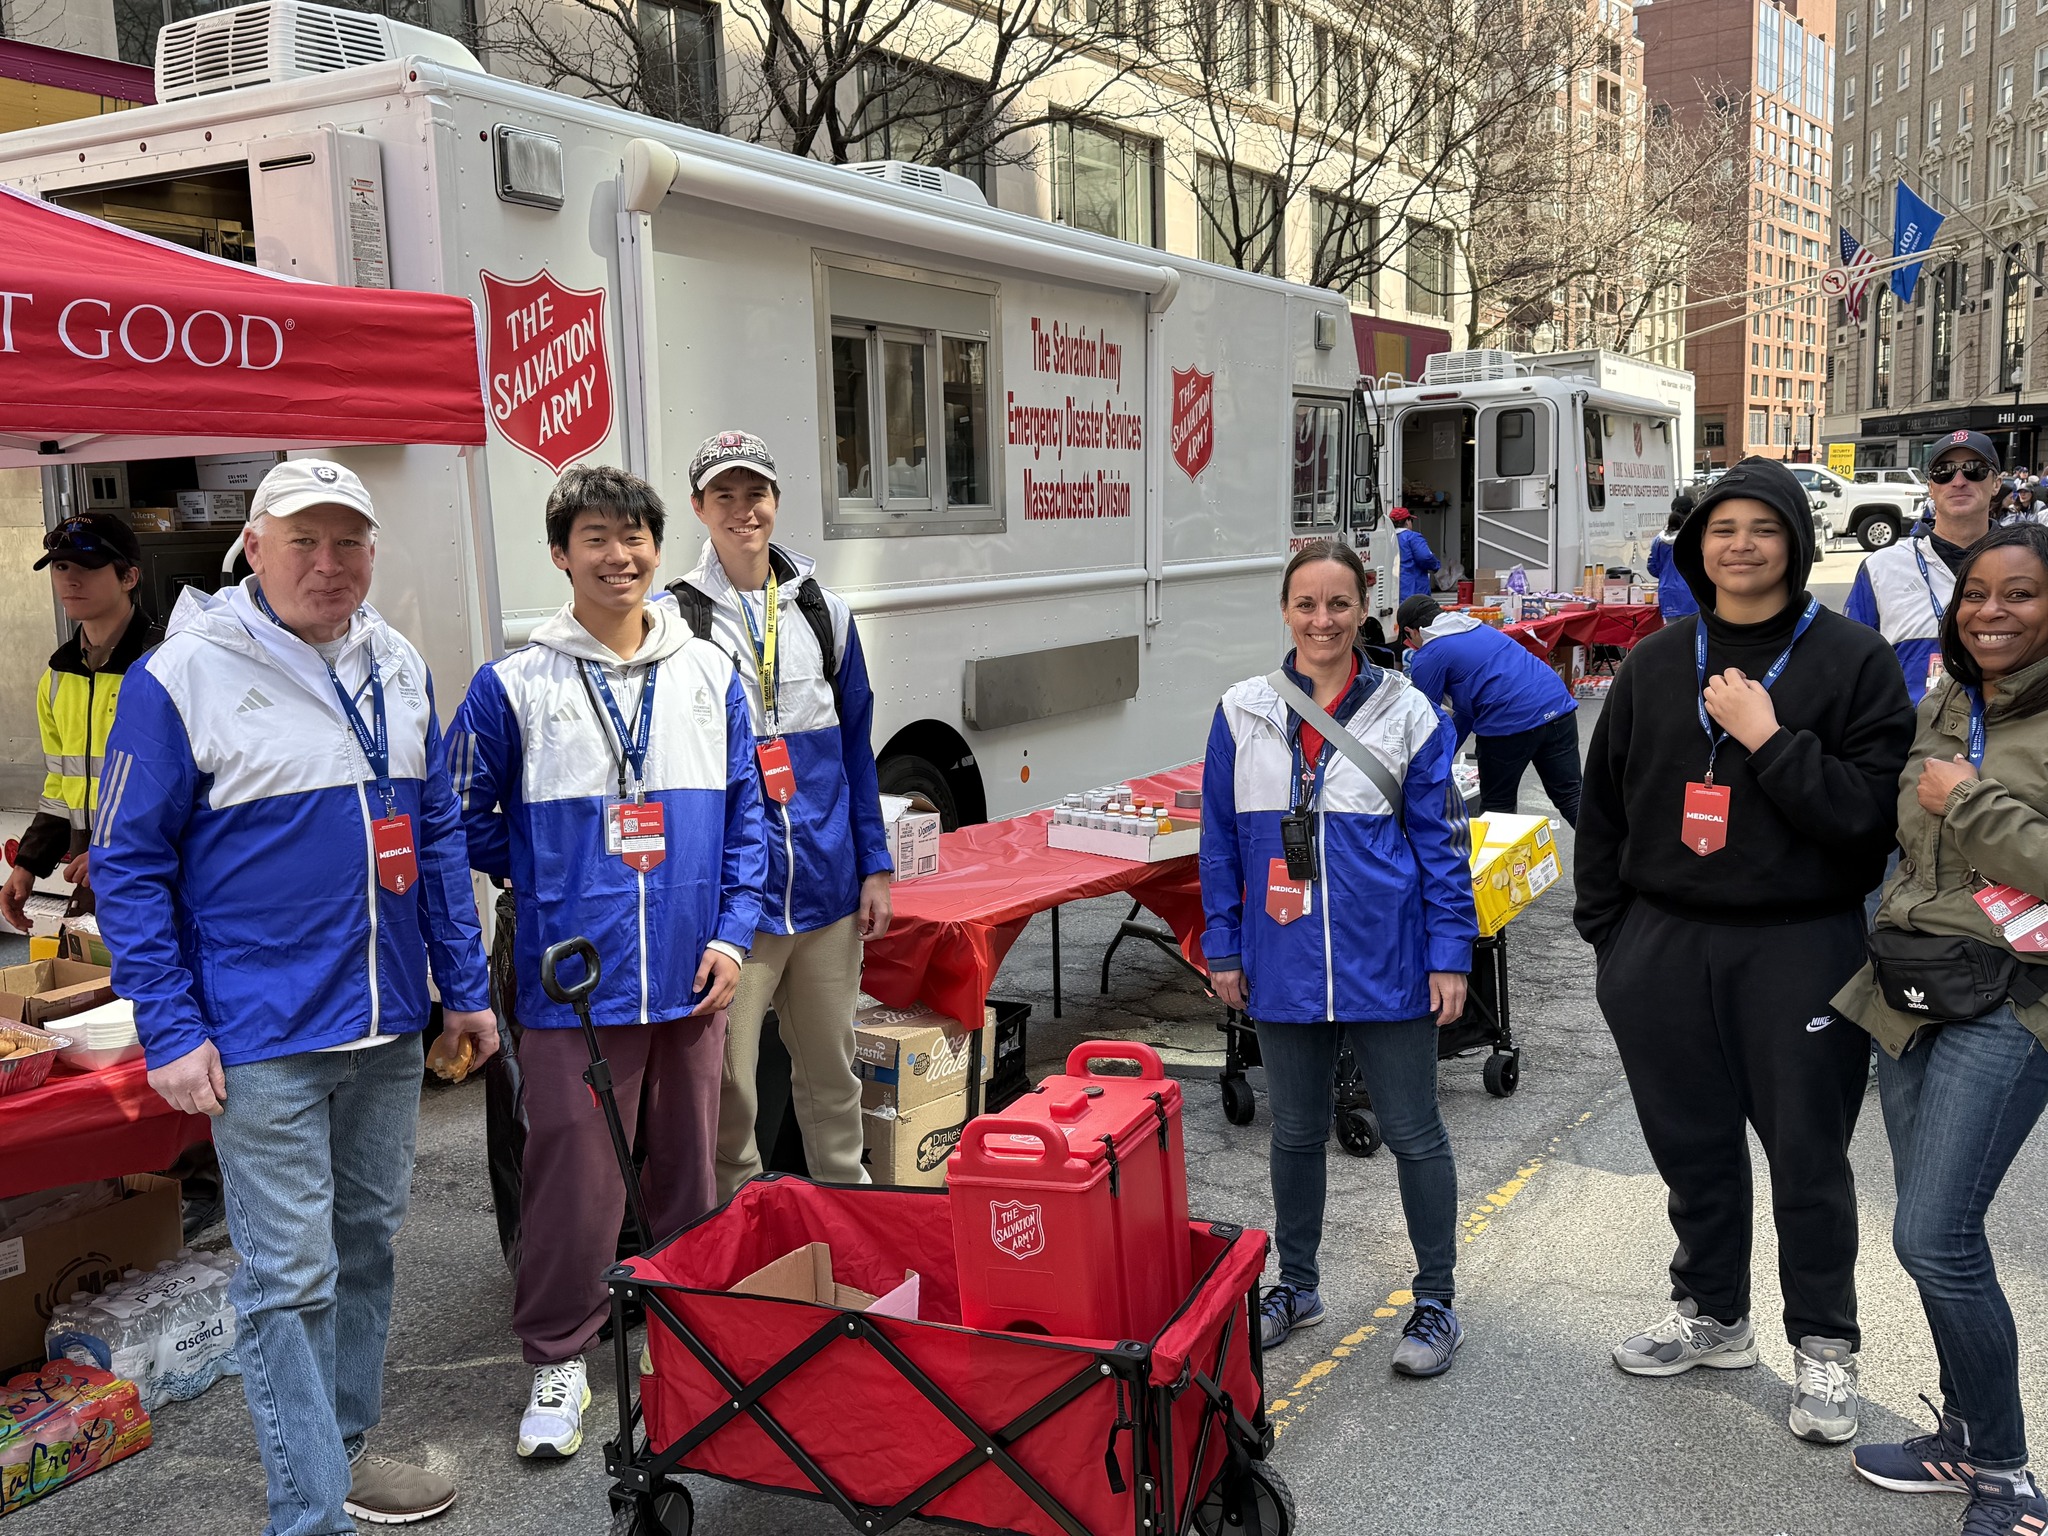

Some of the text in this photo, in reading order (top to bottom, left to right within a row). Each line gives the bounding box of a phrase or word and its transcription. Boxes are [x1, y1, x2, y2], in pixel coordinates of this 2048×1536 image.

[507, 292, 554, 352] THE
[494, 308, 596, 420] SALVATION
[1031, 317, 1122, 394] The Salvation Army
[1179, 376, 1197, 412] THE
[539, 364, 596, 446] ARMY
[1007, 391, 1141, 461] Emergency Disaster Services
[1173, 384, 1210, 452] SALVATION
[1998, 413, 2034, 424] Hilon
[1187, 417, 1209, 466] ARMY
[701, 446, 767, 467] CHAMPS
[1613, 462, 1666, 479] THE SALVATION ARMY
[1831, 464, 1851, 474] #30
[1023, 469, 1130, 520] Massachusetts Division
[1609, 484, 1669, 497] EMERGENCY DISASTER SERVICES
[1360, 550, 1371, 562] 294
[764, 765, 790, 777] MEDICAL
[1686, 811, 1725, 823] MEDICAL
[379, 846, 412, 860] MEDICAL
[1270, 885, 1302, 895] MEDICAL
[1812, 1016, 1831, 1026] NIKE
[1001, 1208, 1019, 1224] THE
[997, 1212, 1036, 1242] SALVATION
[1012, 1227, 1036, 1250] ARMY
[176, 1319, 224, 1351] ascend
[1978, 1484, 2001, 1493] adidas
